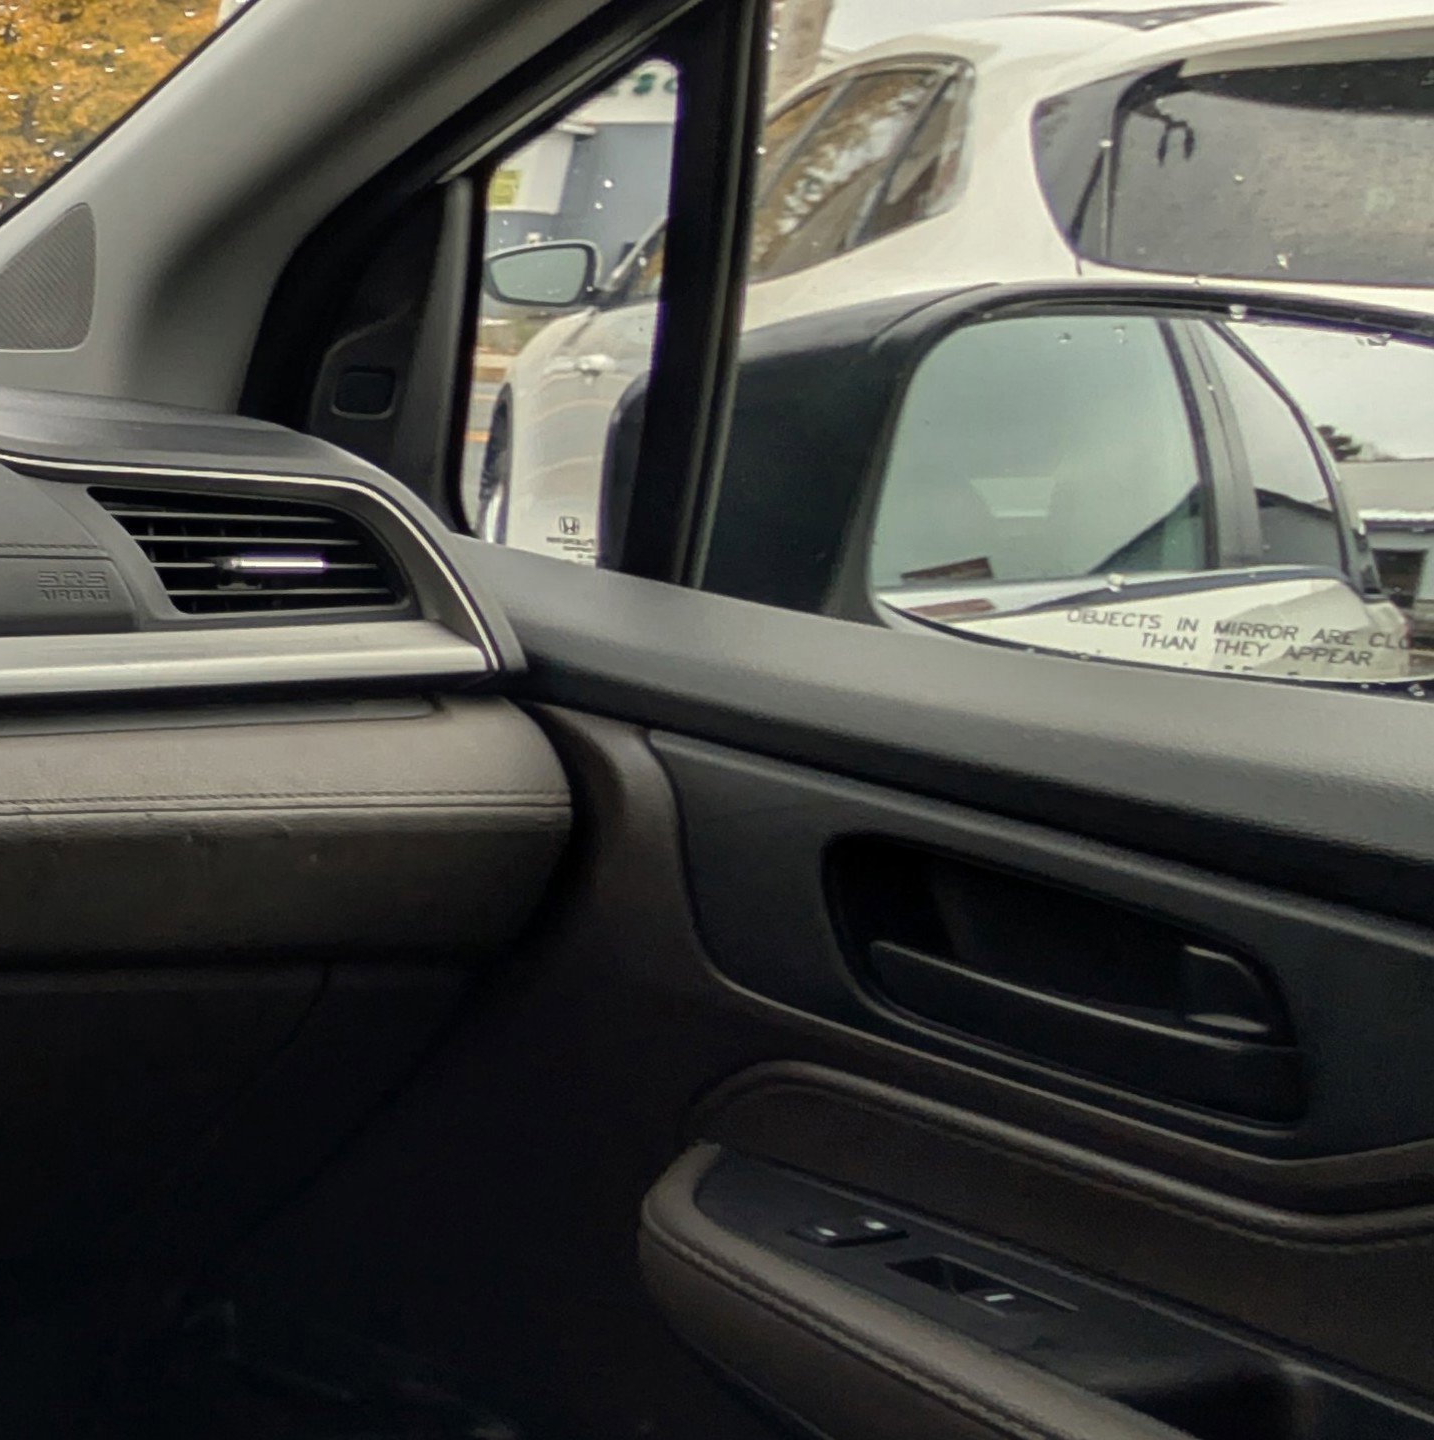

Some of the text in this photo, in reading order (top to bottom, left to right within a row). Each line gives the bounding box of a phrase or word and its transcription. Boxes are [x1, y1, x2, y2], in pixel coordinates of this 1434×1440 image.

[1066, 608, 1163, 630] OBJECTS
[1176, 616, 1200, 632] IN
[1213, 619, 1299, 640] MIRROR
[1312, 627, 1357, 647] ARE
[1141, 634, 1374, 666] THAN THEY APPEAR
